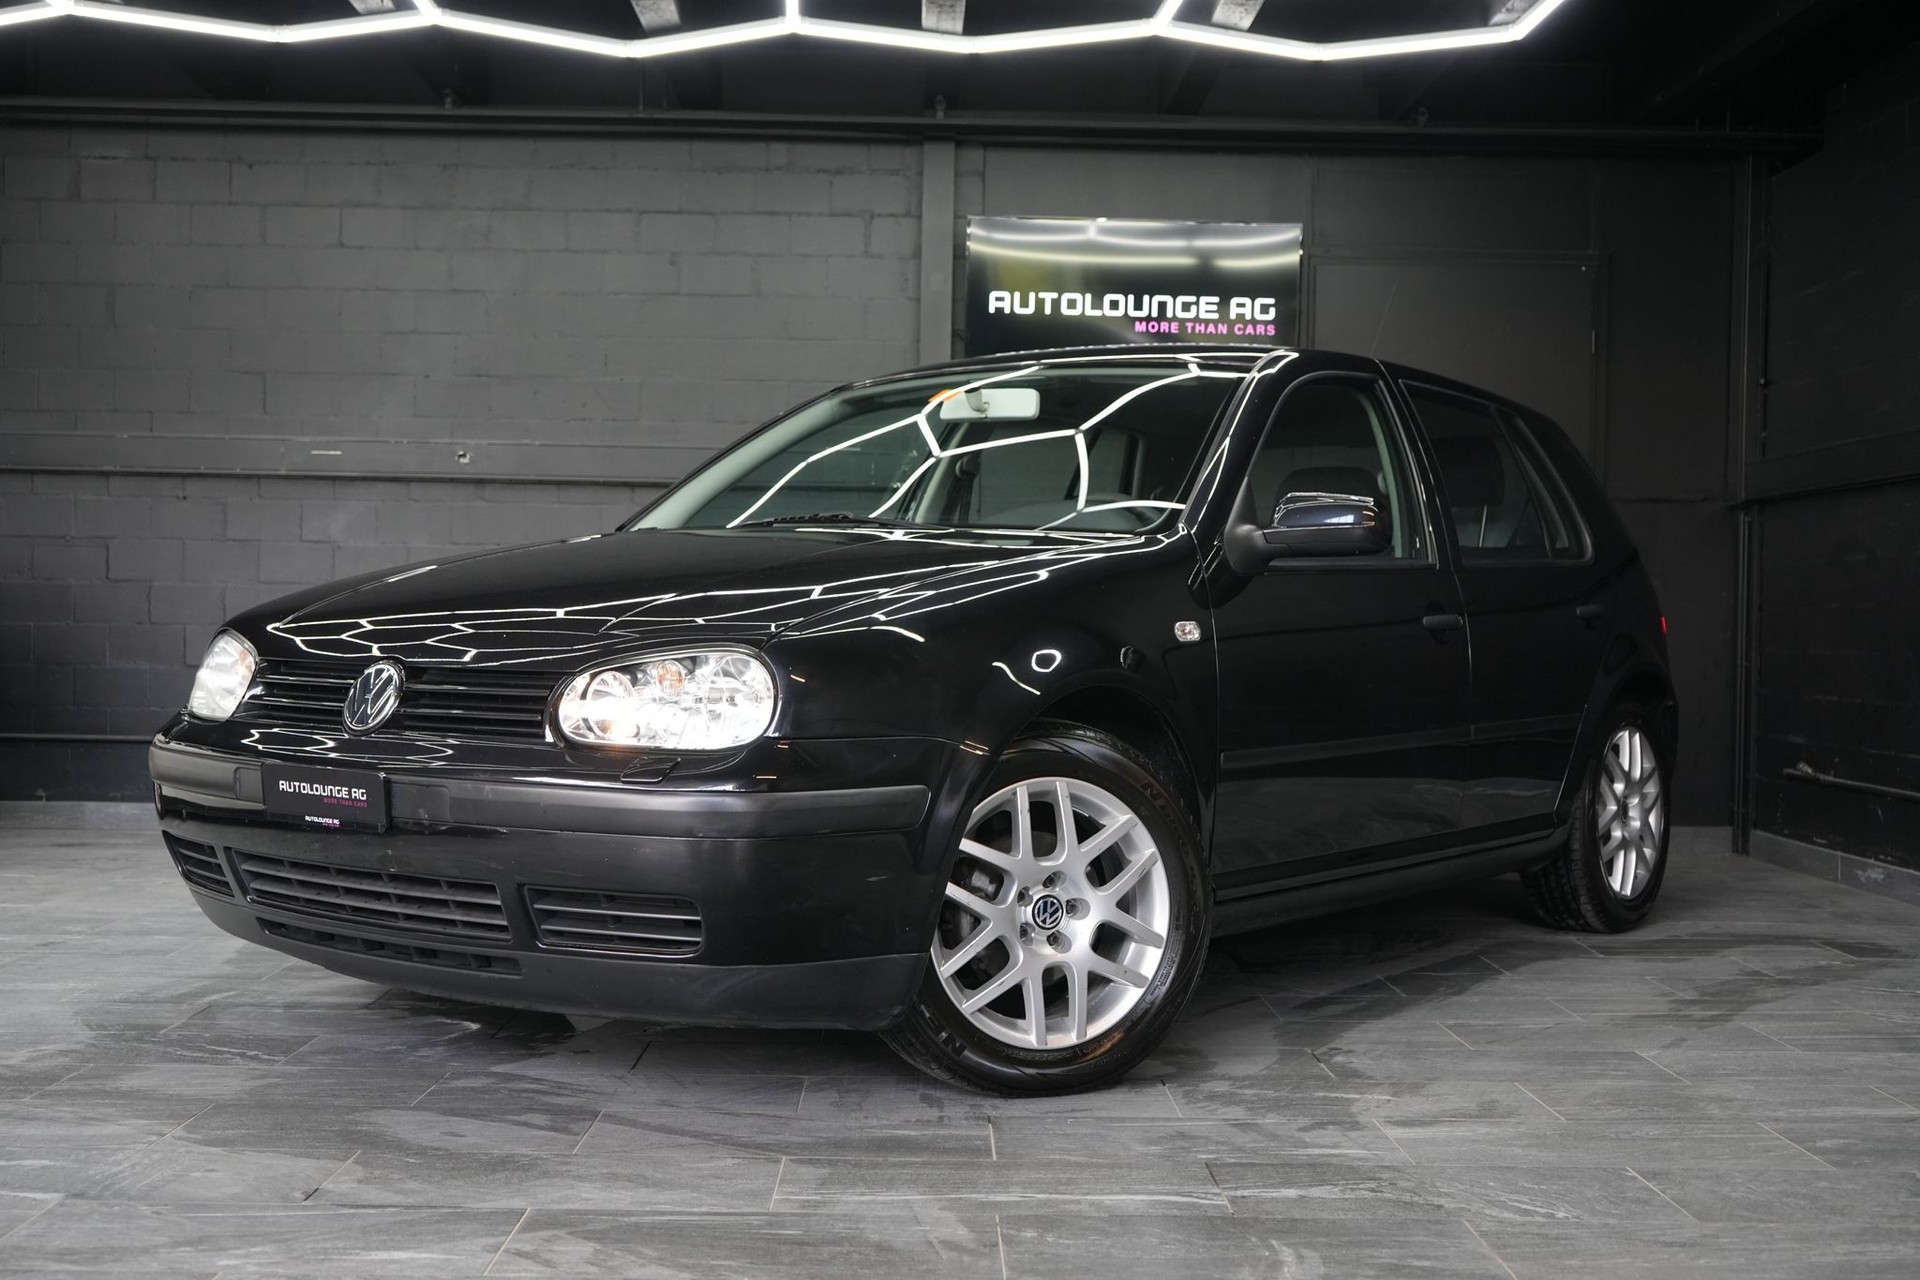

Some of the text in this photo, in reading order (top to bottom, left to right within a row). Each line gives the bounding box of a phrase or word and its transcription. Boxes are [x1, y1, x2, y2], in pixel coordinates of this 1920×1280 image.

[988, 291, 1276, 320] AUTOLOUNGE AG
[1135, 321, 1276, 336] MORE THAN CARS
[279, 780, 367, 800] AUTOLOUNGE AG
